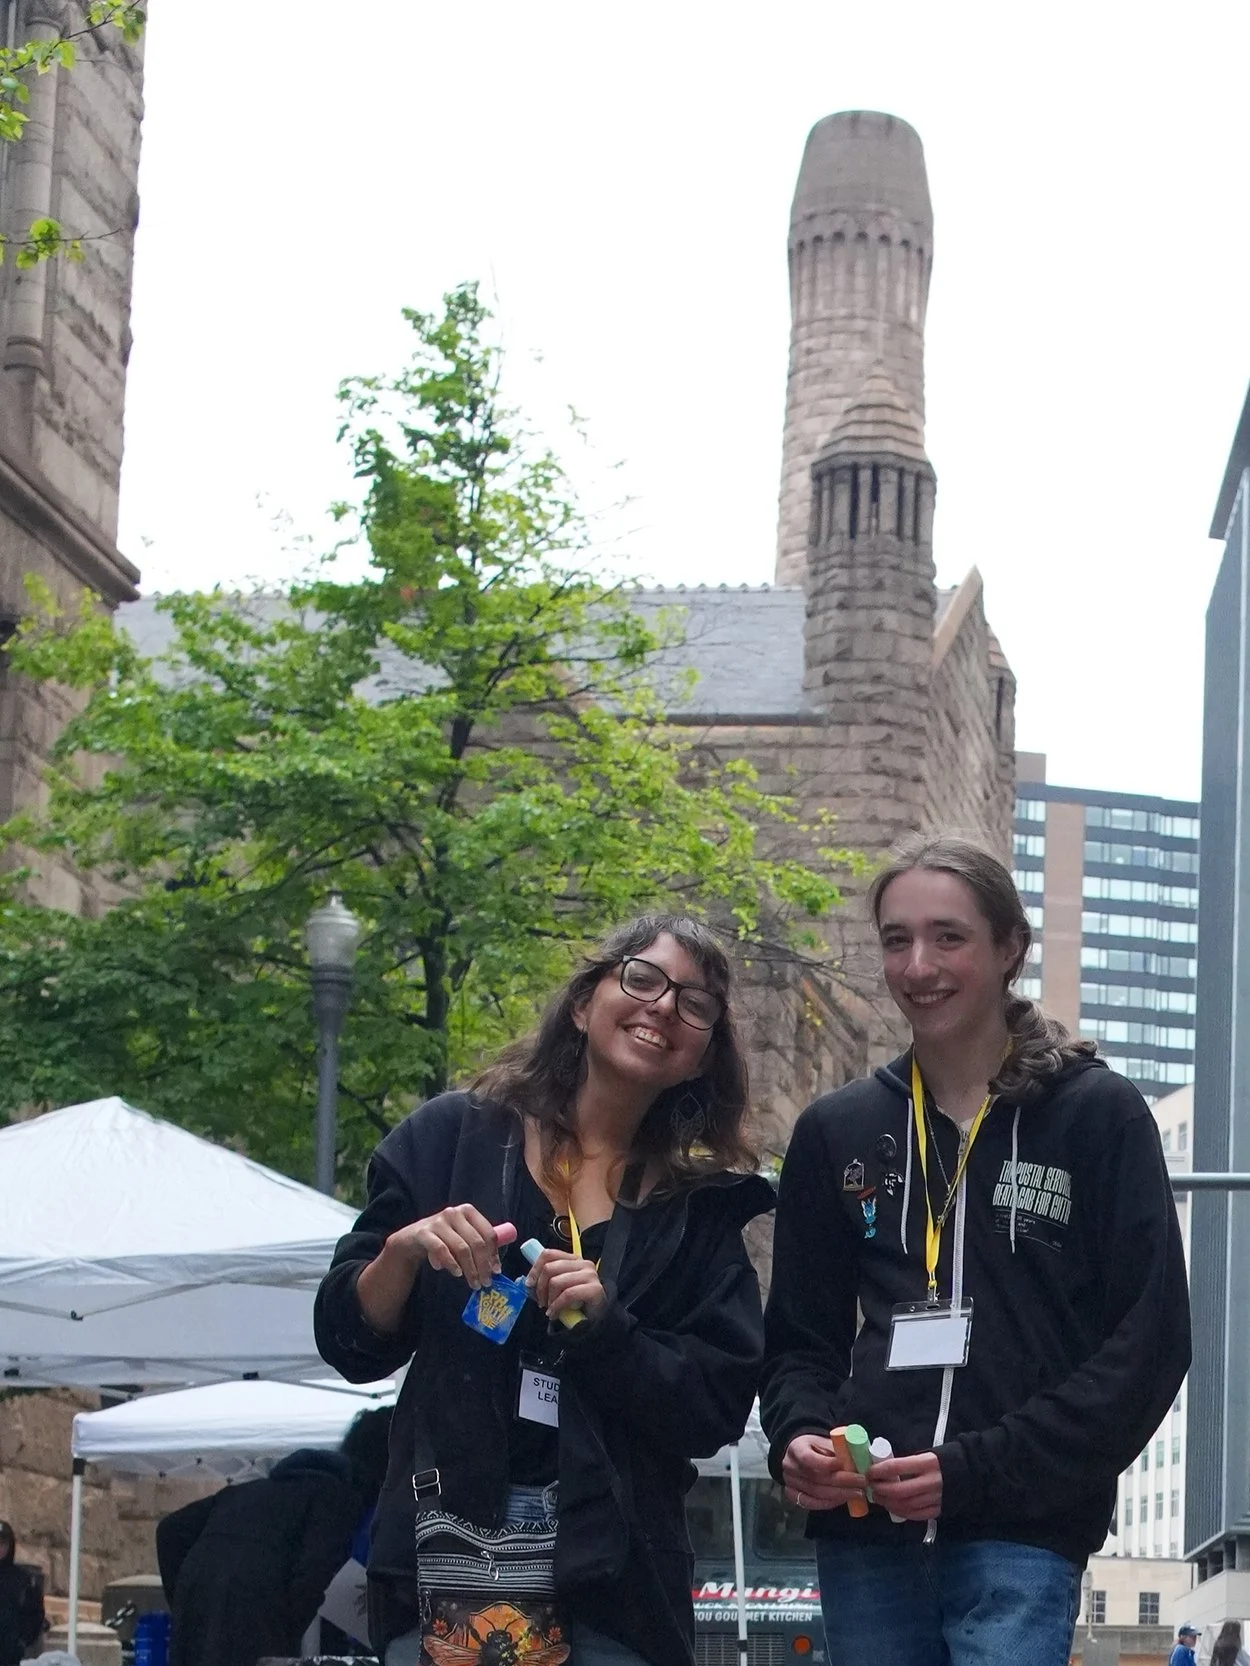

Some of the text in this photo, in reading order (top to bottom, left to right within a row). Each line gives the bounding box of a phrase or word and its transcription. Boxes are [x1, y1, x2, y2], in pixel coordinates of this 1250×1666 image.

[999, 1160, 1012, 1183] TH
[1016, 1161, 1045, 1189] POSTAL
[1017, 1186, 1037, 1212] CAB
[1033, 1190, 1052, 1217] FOR
[533, 1377, 560, 1391] STUD
[537, 1391, 558, 1404] LEA
[714, 1611, 765, 1622] GOUMET
[768, 1611, 814, 1622] KITCHEN
